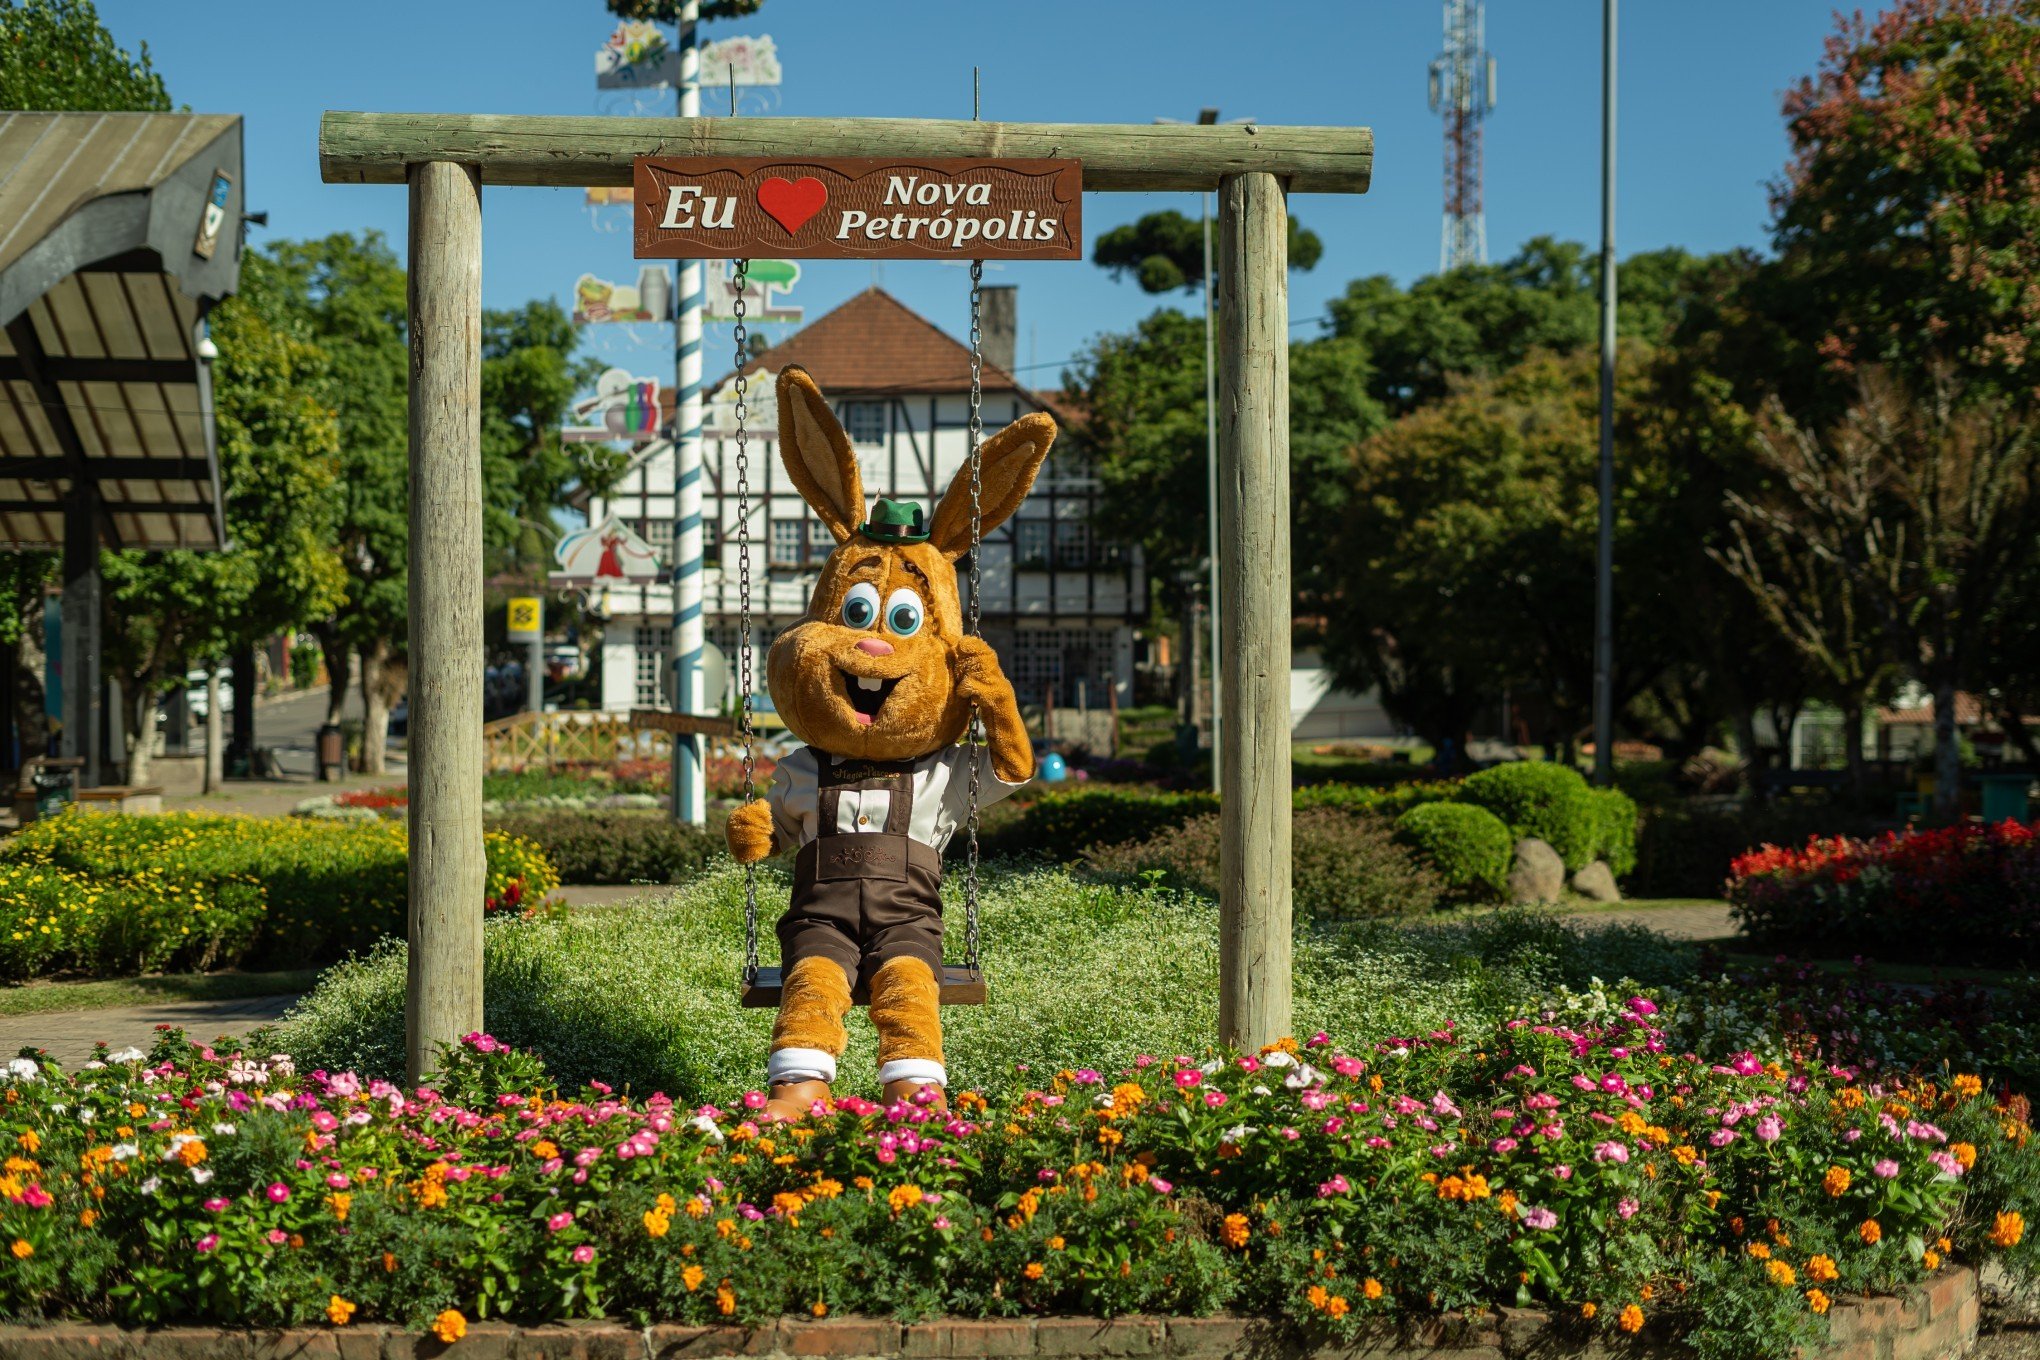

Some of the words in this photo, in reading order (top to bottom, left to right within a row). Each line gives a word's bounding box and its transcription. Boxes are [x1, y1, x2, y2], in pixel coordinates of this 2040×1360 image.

[659, 185, 738, 229] Eu
[882, 175, 992, 206] Nova
[835, 208, 1058, 248] Petrópolis
